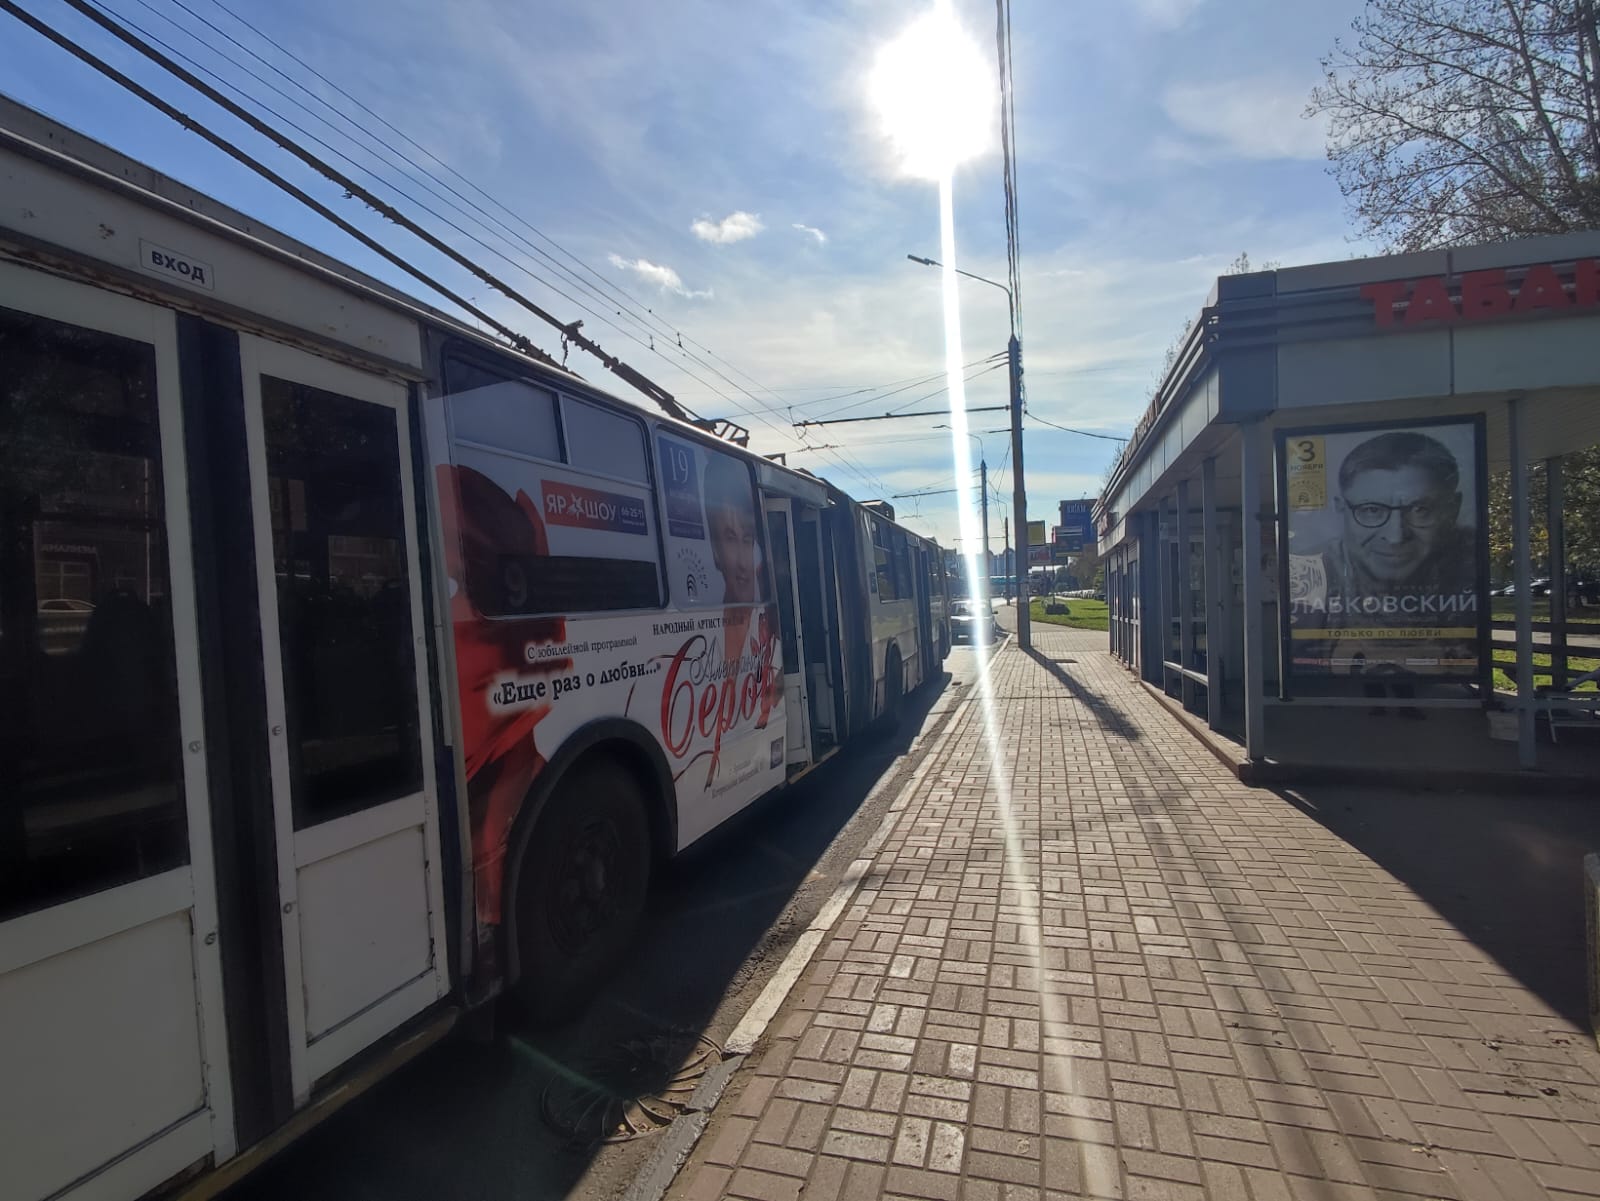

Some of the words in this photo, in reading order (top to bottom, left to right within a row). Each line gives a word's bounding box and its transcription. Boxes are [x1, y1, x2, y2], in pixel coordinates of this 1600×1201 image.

[151, 249, 206, 284] ВХОД
[1297, 439, 1316, 462] 3
[669, 447, 689, 484] 19
[546, 493, 567, 514] ЯР
[584, 499, 617, 521] ШОУ
[1290, 590, 1478, 615] ЛАБКОВСКИЙ
[652, 618, 695, 637] НАРОДНЫЙ
[697, 617, 721, 631] АРТИСТ
[527, 646, 536, 660] С
[538, 640, 590, 659] юбилейной
[591, 636, 638, 655] программой
[492, 681, 547, 706] «Еще
[551, 674, 582, 701] раз
[585, 671, 597, 688] о
